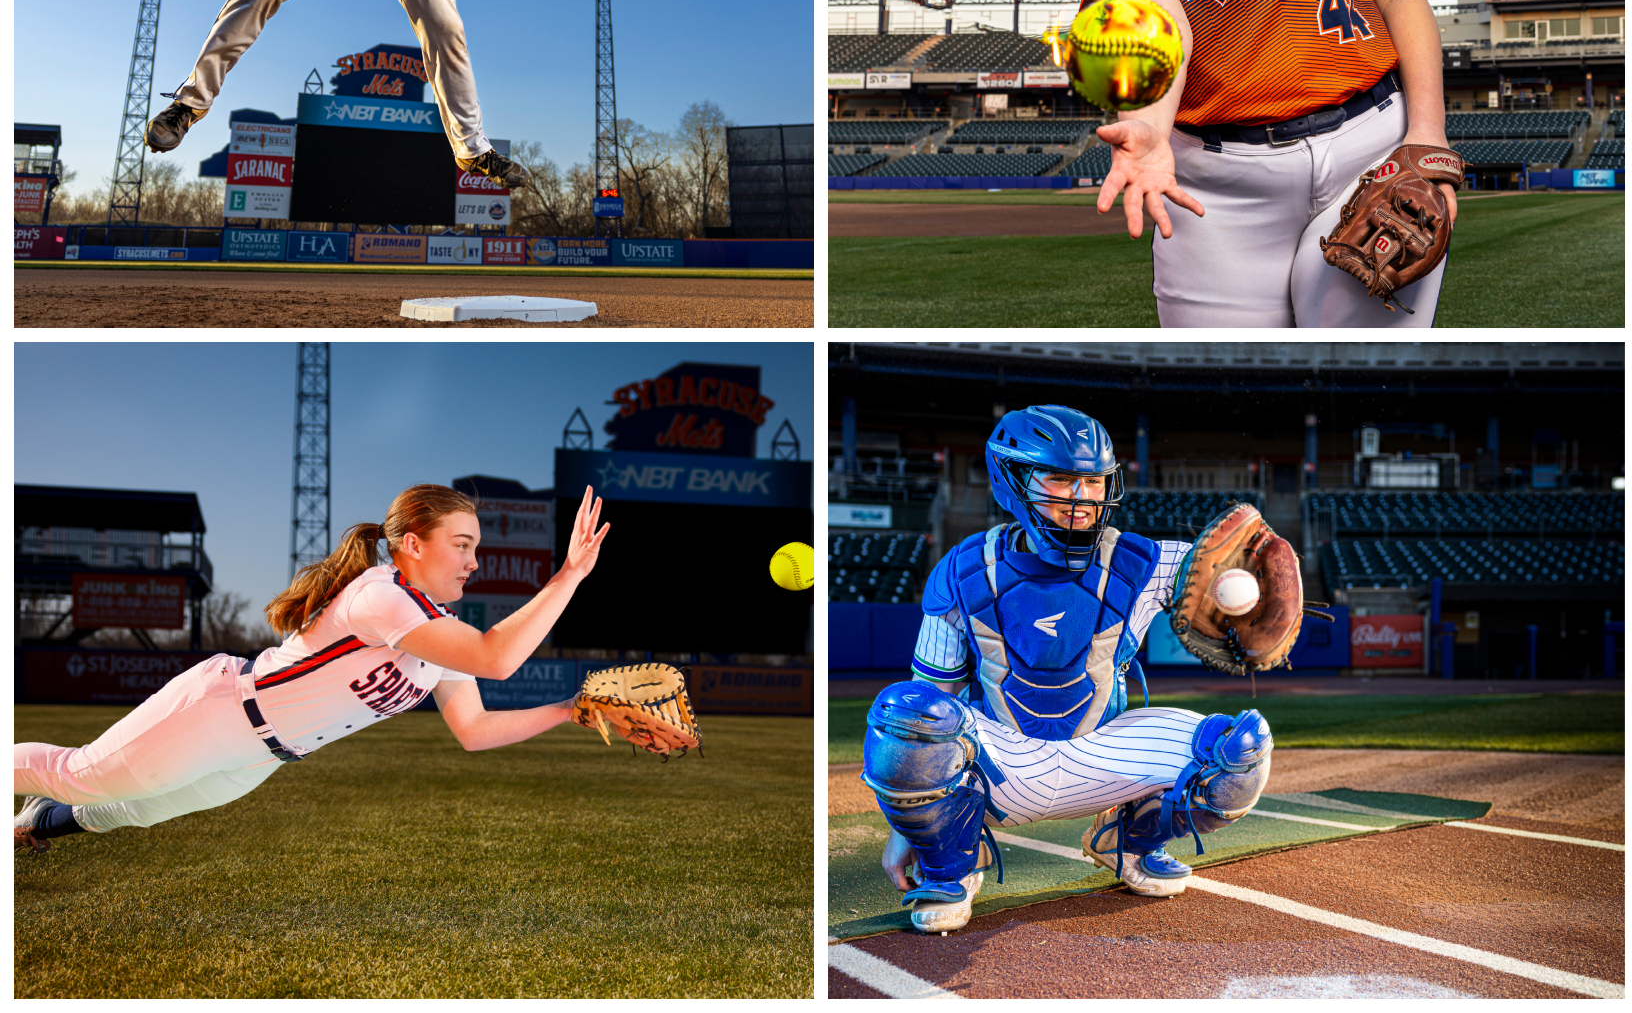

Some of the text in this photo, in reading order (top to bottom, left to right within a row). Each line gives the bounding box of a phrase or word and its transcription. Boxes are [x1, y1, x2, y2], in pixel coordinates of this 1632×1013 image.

[362, 73, 405, 97] Mets
[984, 78, 1014, 87] 1260
[342, 104, 435, 126] NBT BANK
[236, 124, 292, 135] ELECTRICIANS
[236, 135, 290, 145] IBEW NECA
[233, 159, 287, 183] SARANAC
[458, 204, 486, 214] LET'S GO
[231, 231, 280, 244] UPSTATE
[371, 238, 421, 248] ROMANO
[557, 240, 609, 248] EARN MORE.
[229, 249, 244, 257] Where
[430, 247, 479, 258] TASTE NY
[485, 240, 524, 254] 1911
[557, 248, 608, 257] BUILD YOUR
[621, 243, 675, 258] UPSTATE
[557, 256, 593, 265] FUTURE.
[612, 375, 776, 426] SYRACUSE
[655, 412, 726, 449] Mets
[621, 465, 773, 495] NBT BANK
[79, 580, 128, 595] JUNK
[1352, 624, 1400, 649] Bally
[719, 671, 805, 688] ROMANO
